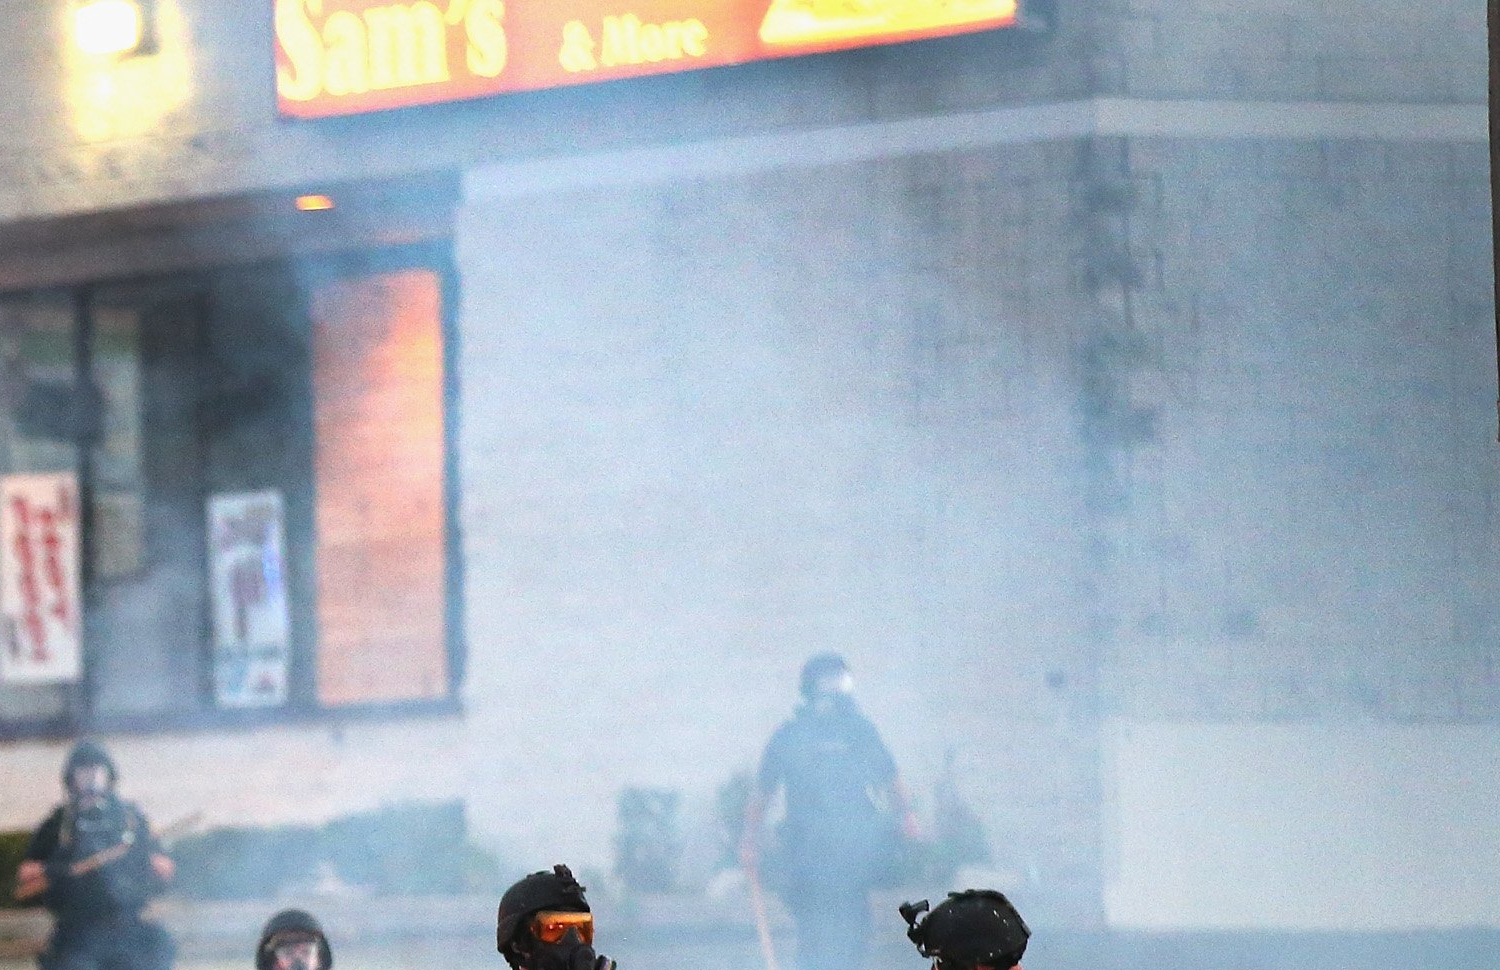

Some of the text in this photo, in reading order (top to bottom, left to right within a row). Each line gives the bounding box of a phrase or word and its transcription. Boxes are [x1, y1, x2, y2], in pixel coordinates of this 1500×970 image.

[275, 0, 708, 100] Sam's & More
